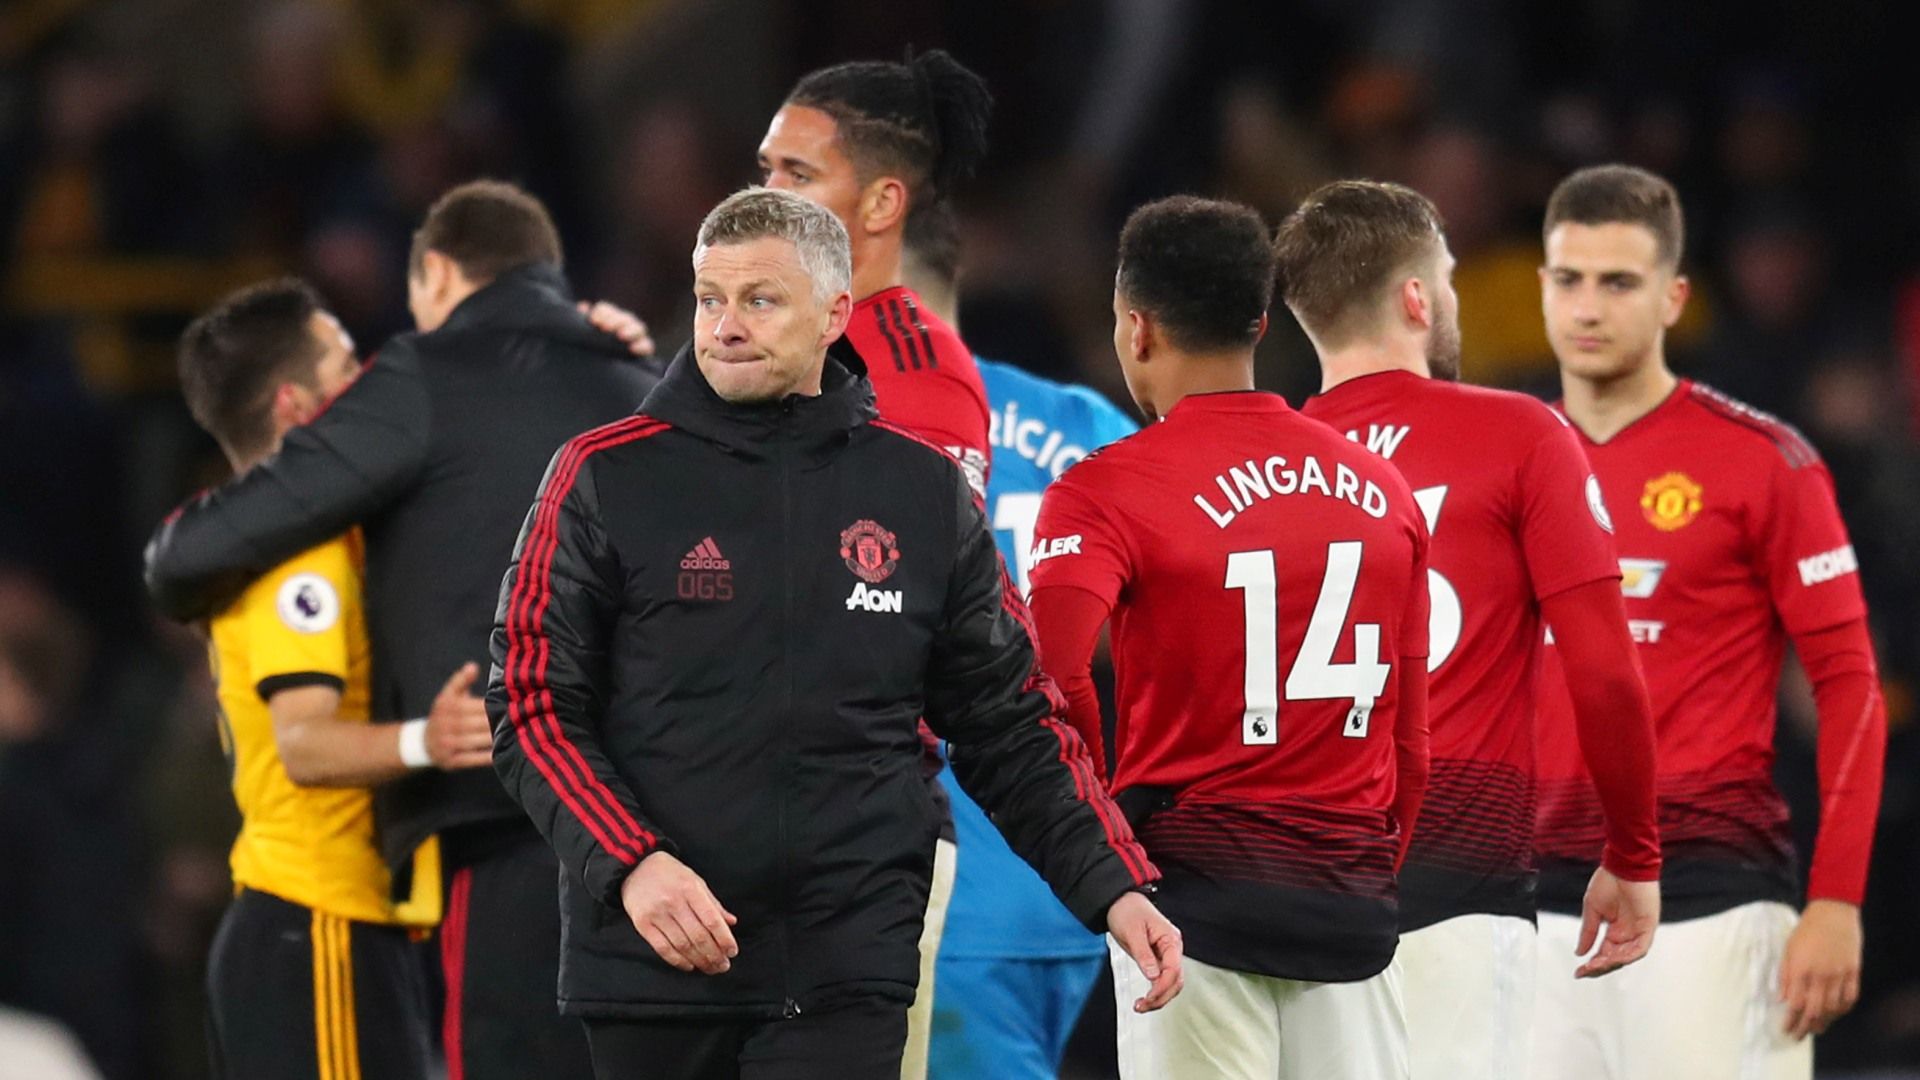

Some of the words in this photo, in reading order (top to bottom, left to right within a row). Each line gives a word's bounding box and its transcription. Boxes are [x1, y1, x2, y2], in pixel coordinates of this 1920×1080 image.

[1193, 455, 1388, 529] LINGARD
[680, 557, 730, 570] adidas
[1224, 540, 1391, 745] 14
